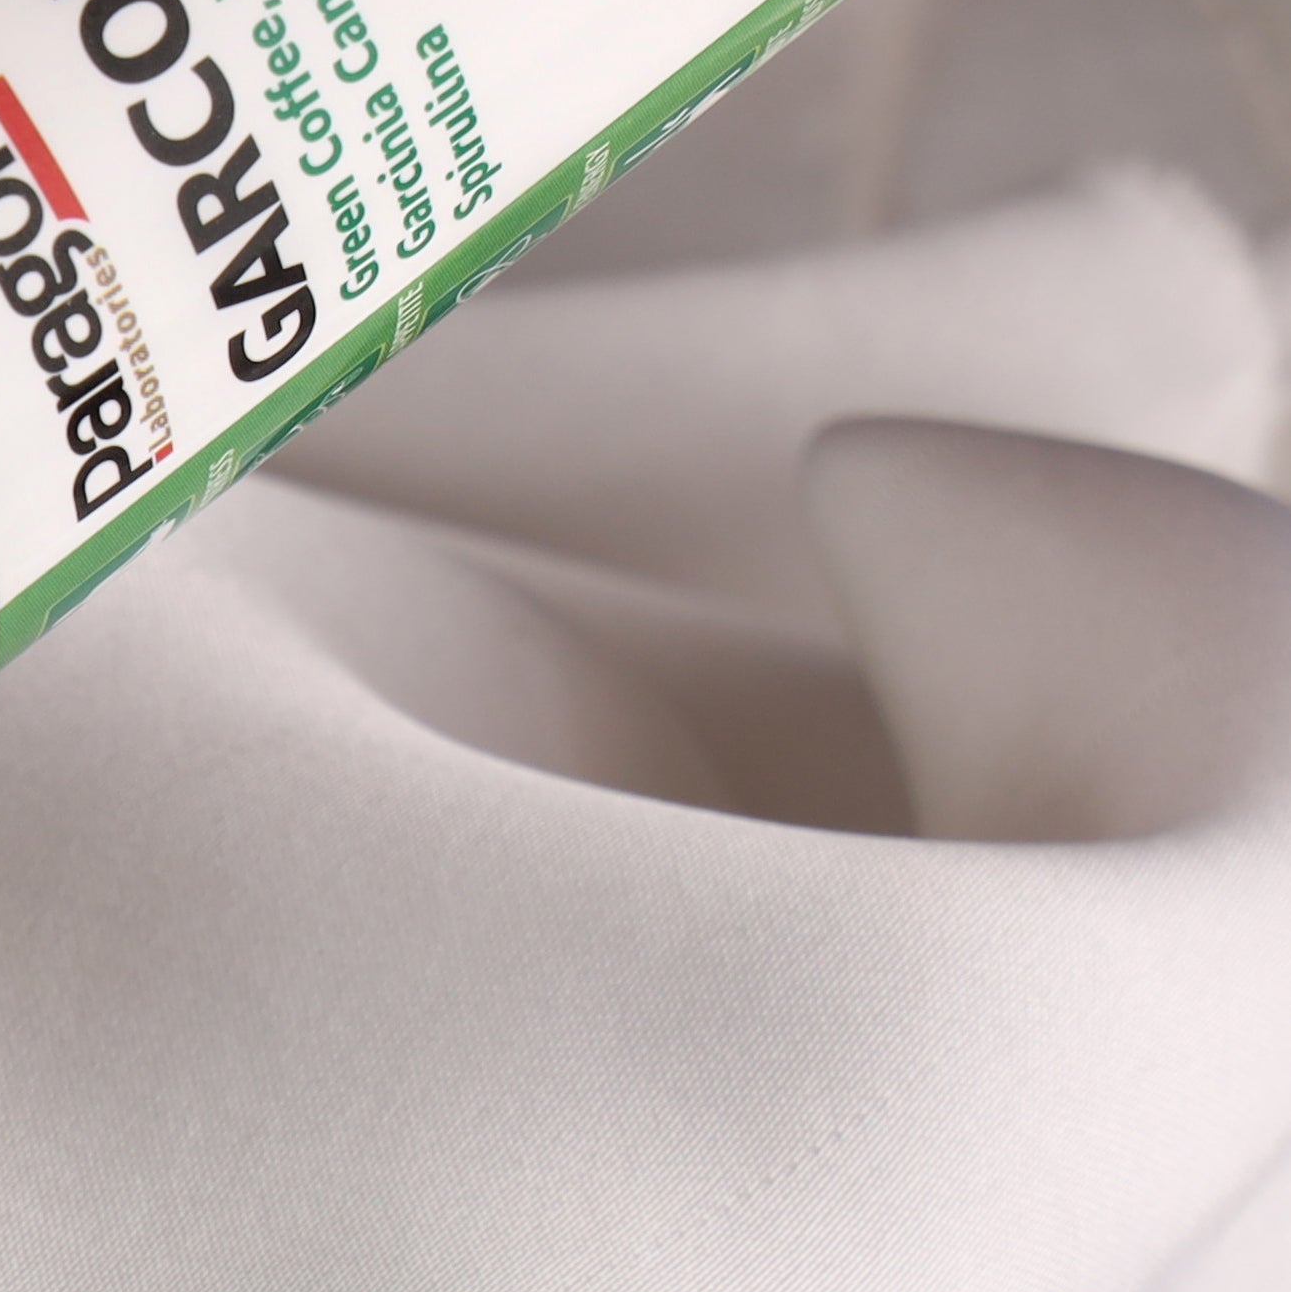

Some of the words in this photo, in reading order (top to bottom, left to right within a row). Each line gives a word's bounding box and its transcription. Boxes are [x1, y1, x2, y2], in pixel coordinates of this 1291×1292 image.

[361, 83, 437, 259] Garcinia
[416, 23, 503, 221] Spirulina
[326, 174, 380, 302] Green
